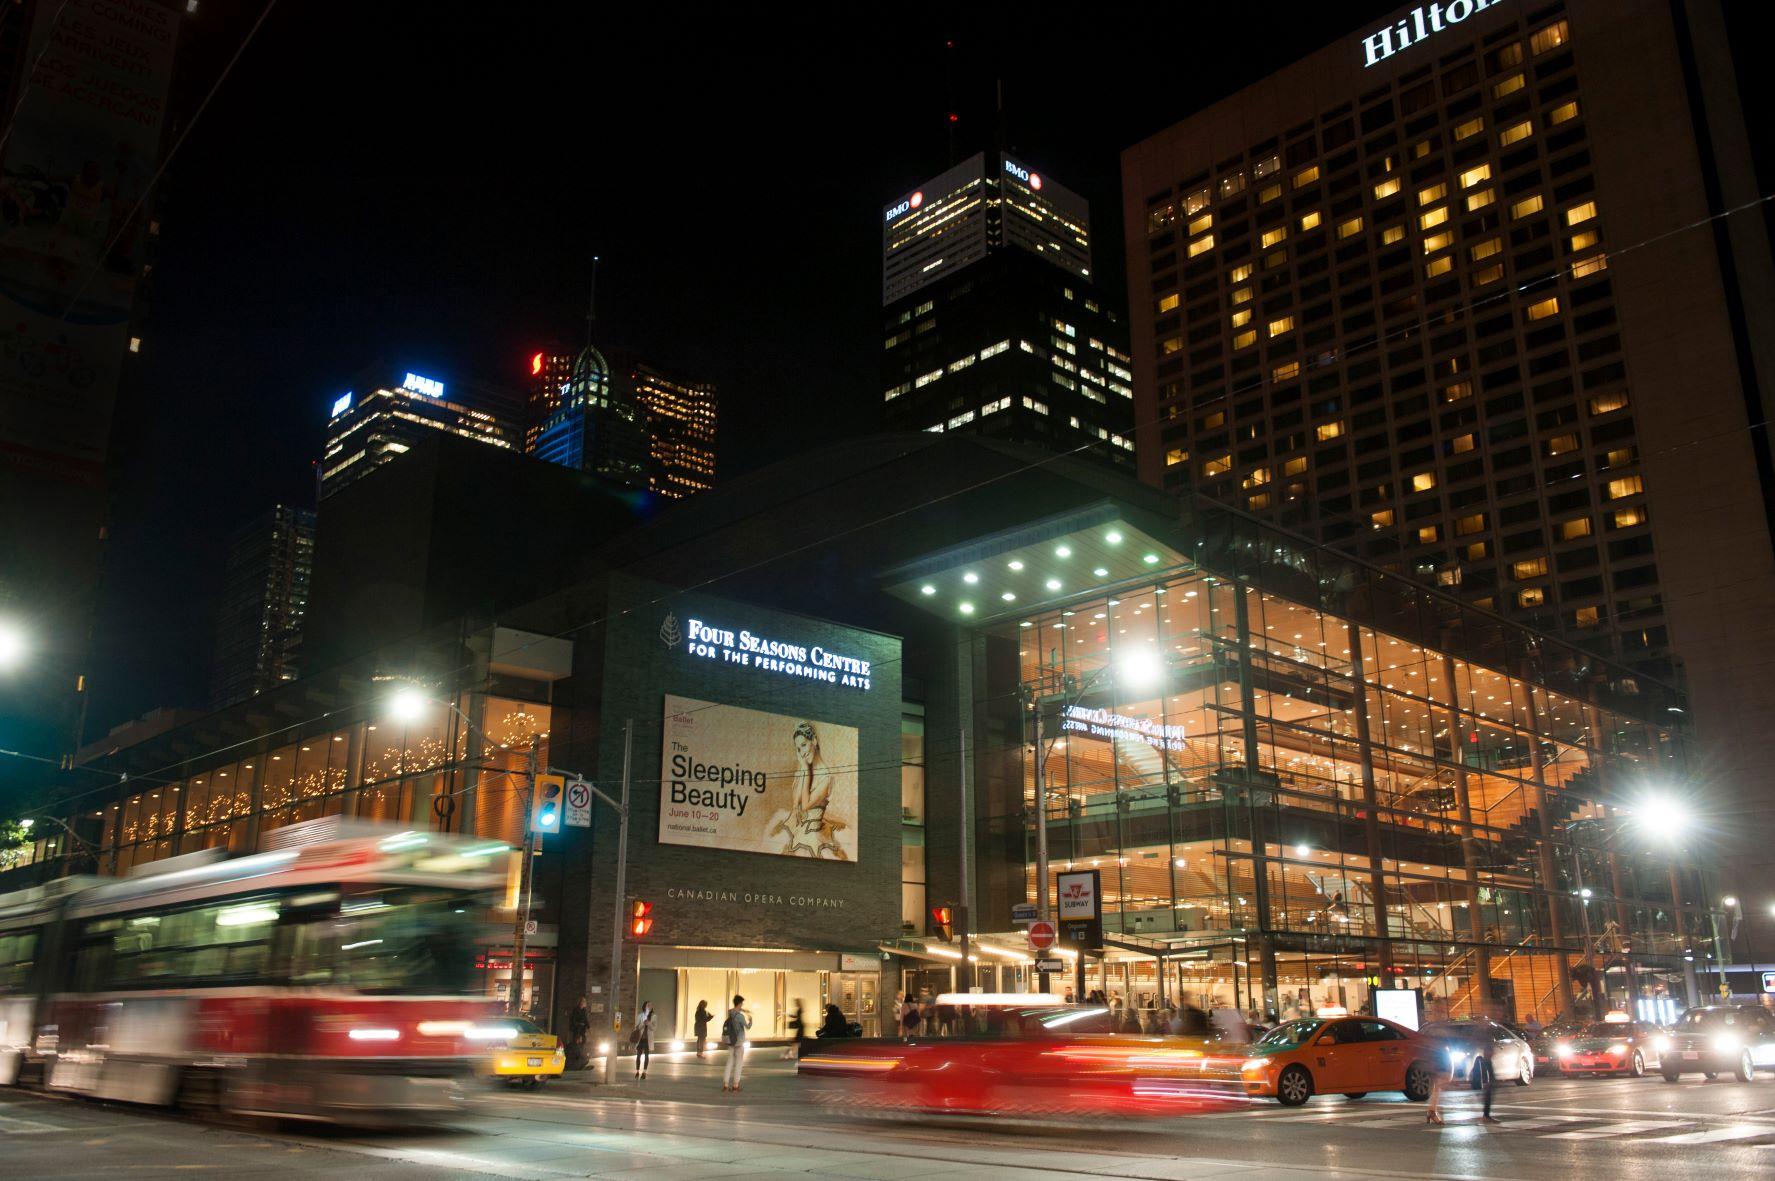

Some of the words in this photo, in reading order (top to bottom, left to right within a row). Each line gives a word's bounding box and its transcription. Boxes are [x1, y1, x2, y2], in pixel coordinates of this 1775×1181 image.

[59, 16, 97, 40] LES
[82, 73, 161, 112] JUEGOS
[1005, 160, 1029, 181] BMO
[886, 201, 909, 221] BMO
[688, 619, 735, 647] FOUR
[739, 631, 807, 662] SEASONS
[811, 647, 871, 676] CENTRE
[689, 643, 716, 658] FOR
[723, 650, 749, 665] THE
[755, 657, 836, 682] PERFORMING
[841, 675, 871, 690] ARTS
[671, 741, 688, 753] The
[671, 754, 767, 794] Sleeping
[671, 780, 748, 816] Beauty
[668, 807, 689, 819] June
[667, 888, 737, 901] CANADIAN
[744, 893, 783, 904] OPERA
[789, 896, 844, 908] COMPANY
[1064, 900, 1089, 909] SUBWAY
